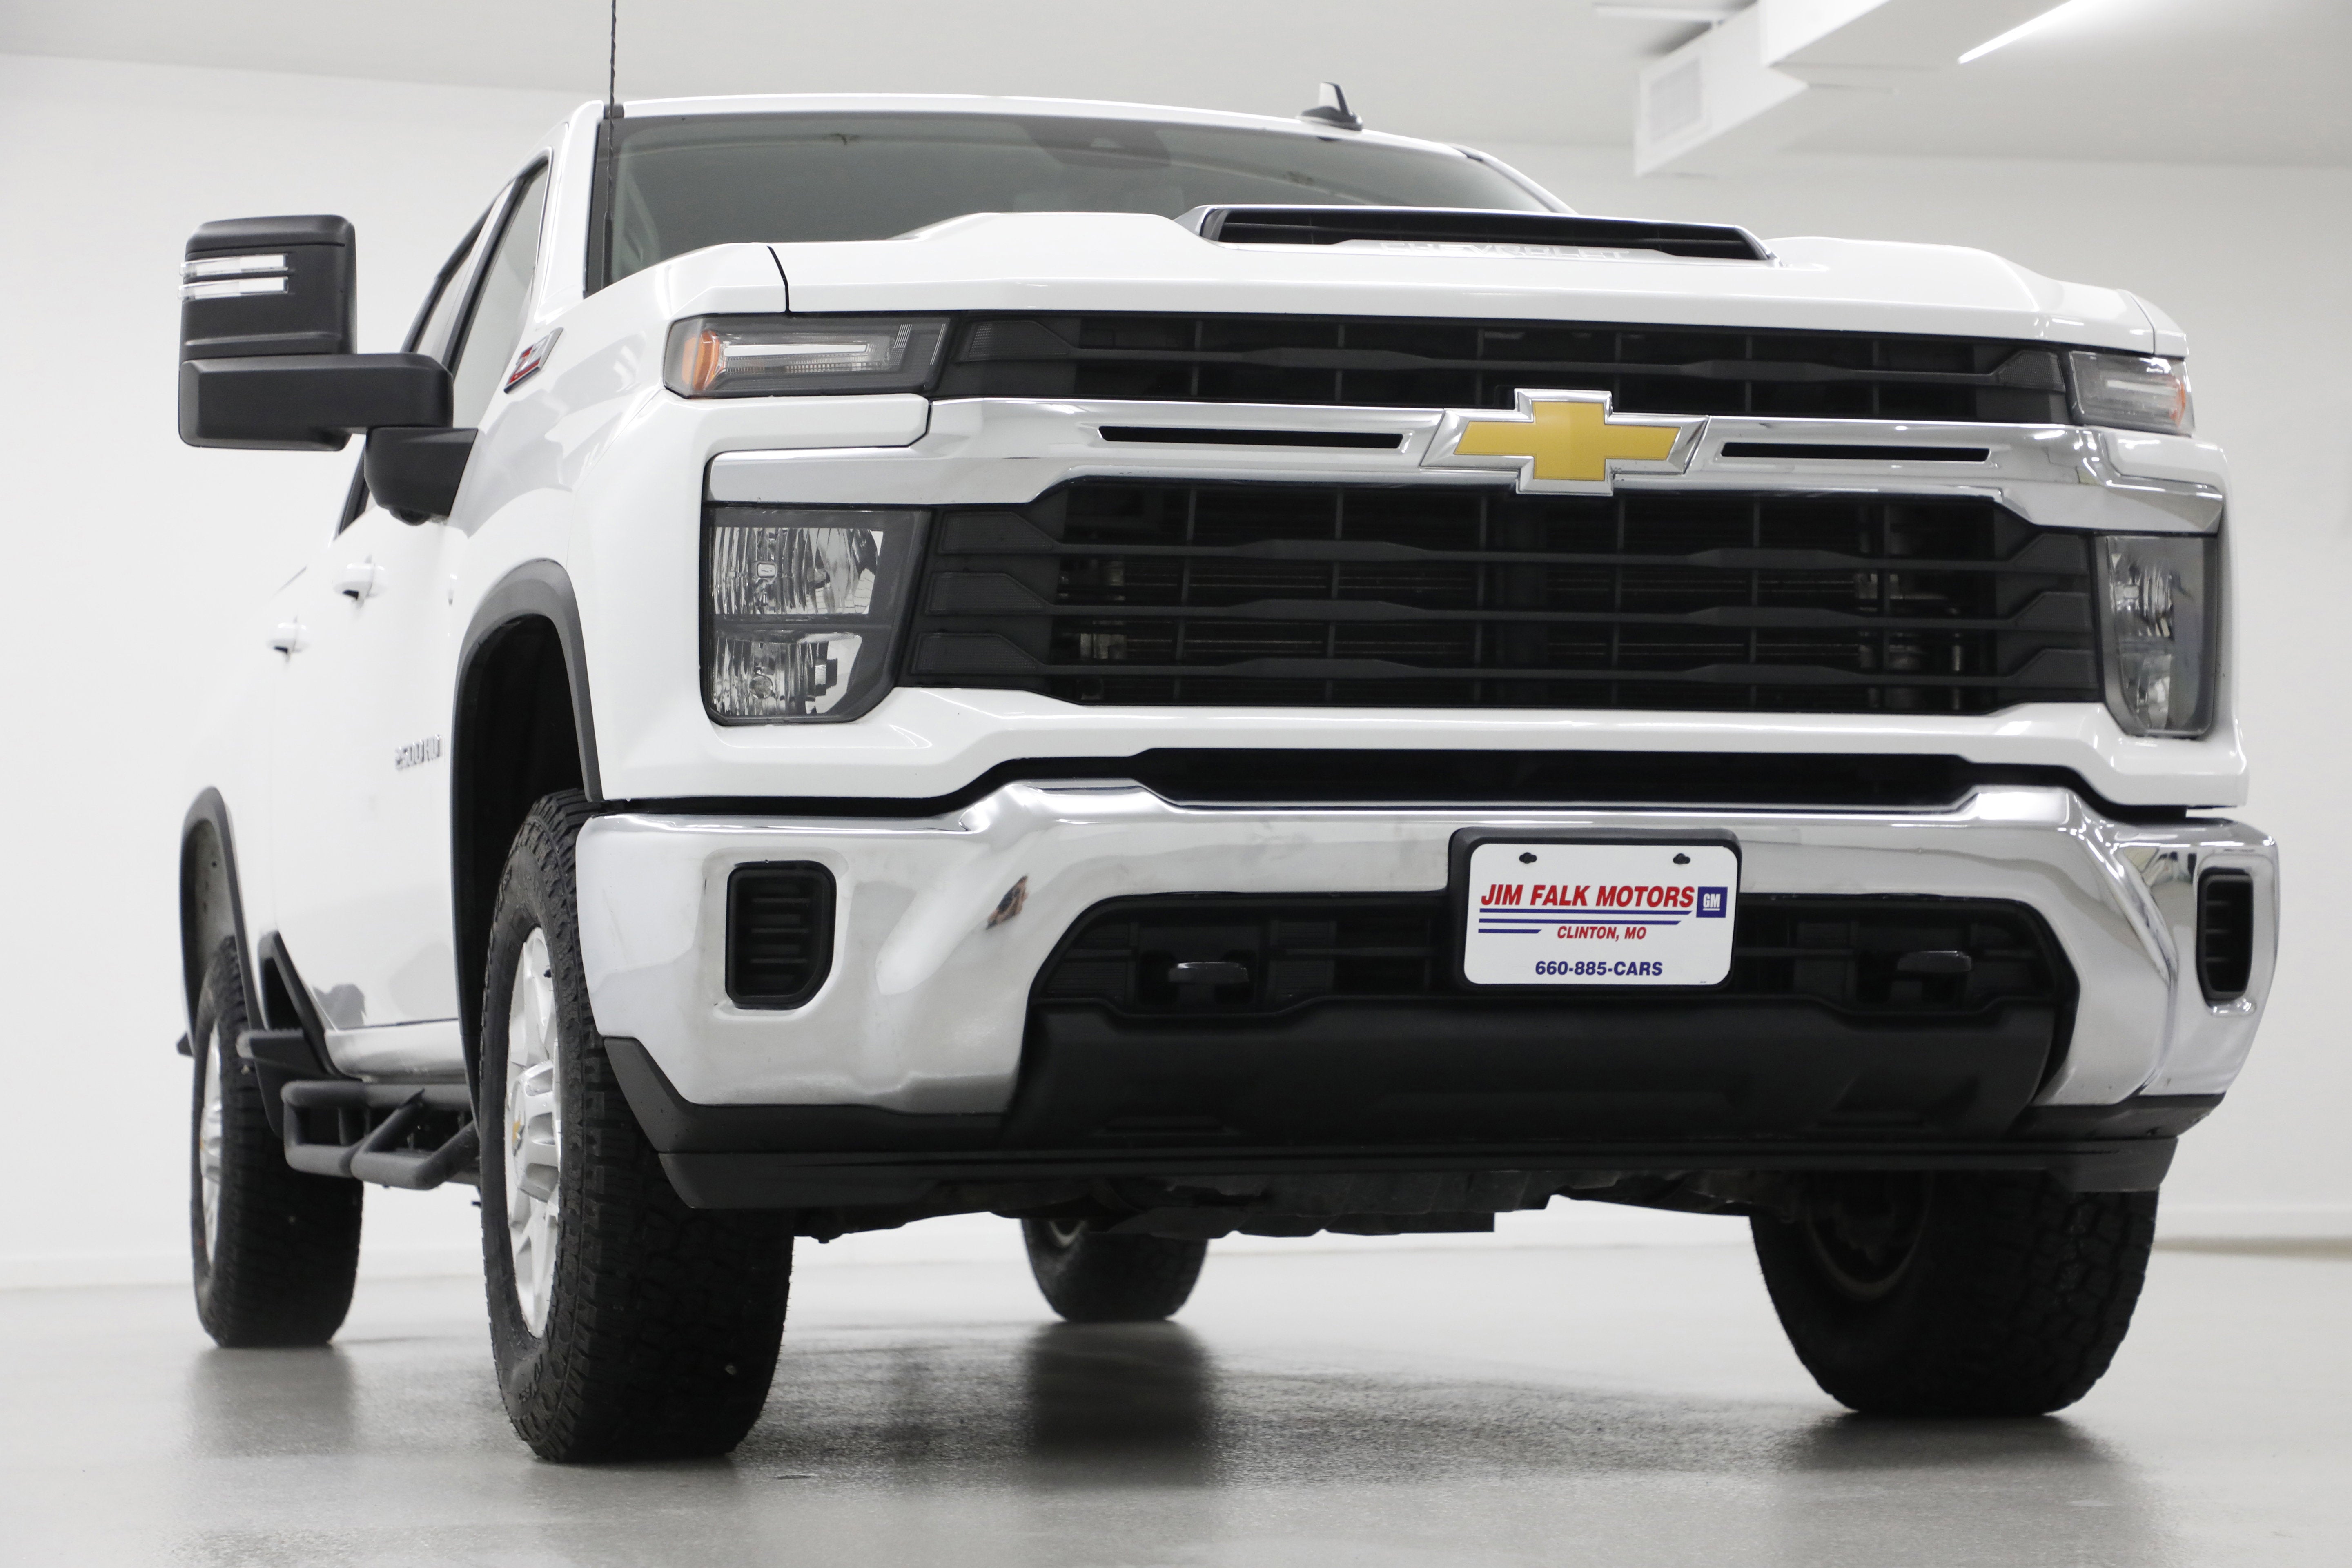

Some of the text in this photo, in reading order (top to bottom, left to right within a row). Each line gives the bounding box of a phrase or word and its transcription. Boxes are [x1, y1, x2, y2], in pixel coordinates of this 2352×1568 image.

[1379, 242, 1629, 260] CHEVROLET
[1481, 884, 1695, 908] JIM FALK MOTORS
[1703, 893, 1721, 911] GM
[1557, 926, 1646, 942] CLINTON, MO
[1535, 961, 1662, 976] 660-885-CARS
